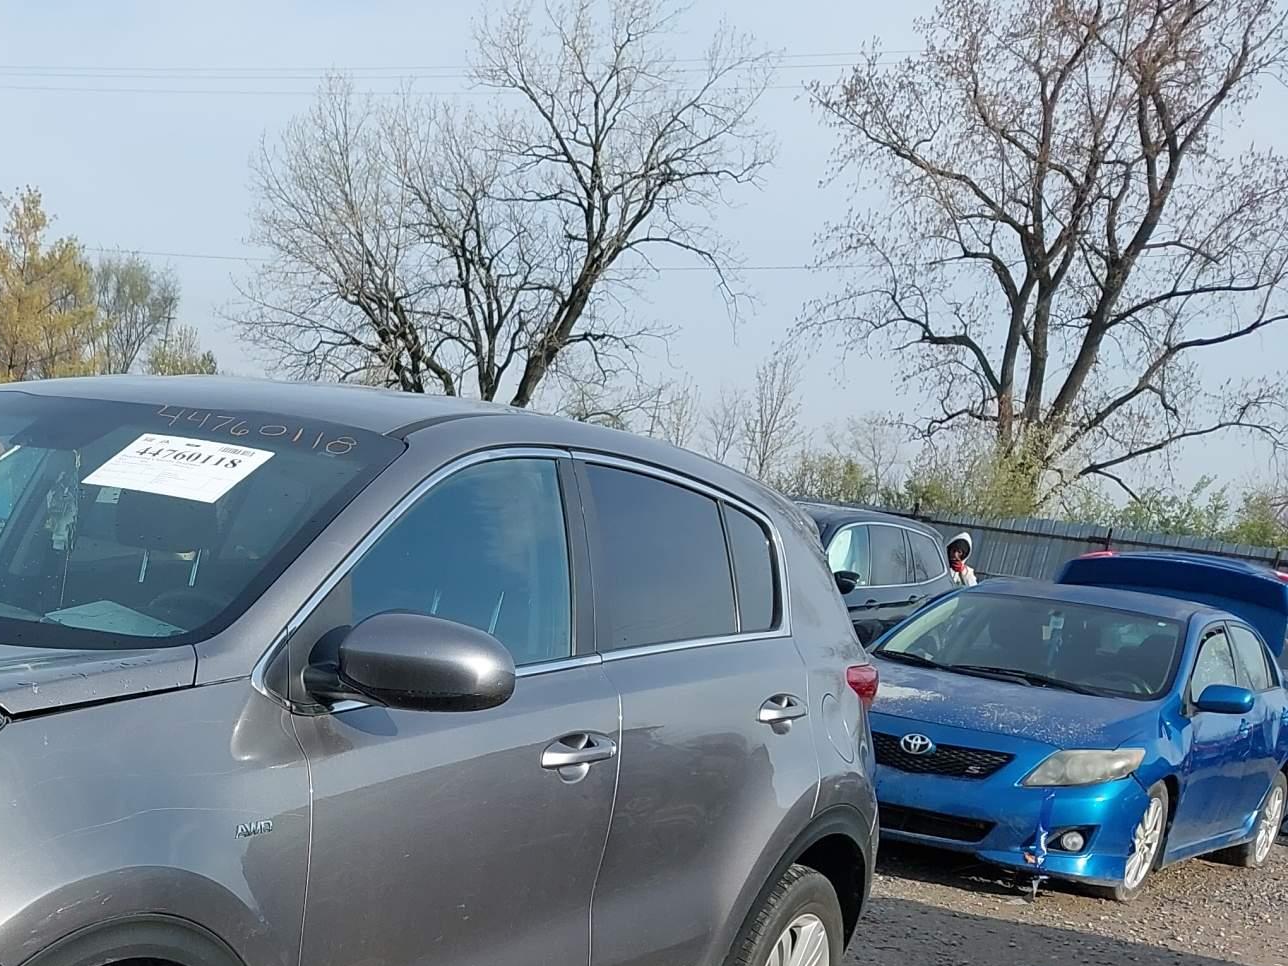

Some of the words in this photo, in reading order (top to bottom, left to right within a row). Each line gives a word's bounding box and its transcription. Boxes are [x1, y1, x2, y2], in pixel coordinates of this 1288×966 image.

[157, 404, 358, 455] 44760118
[135, 445, 243, 470] 44760118
[234, 819, 274, 840] AWD
